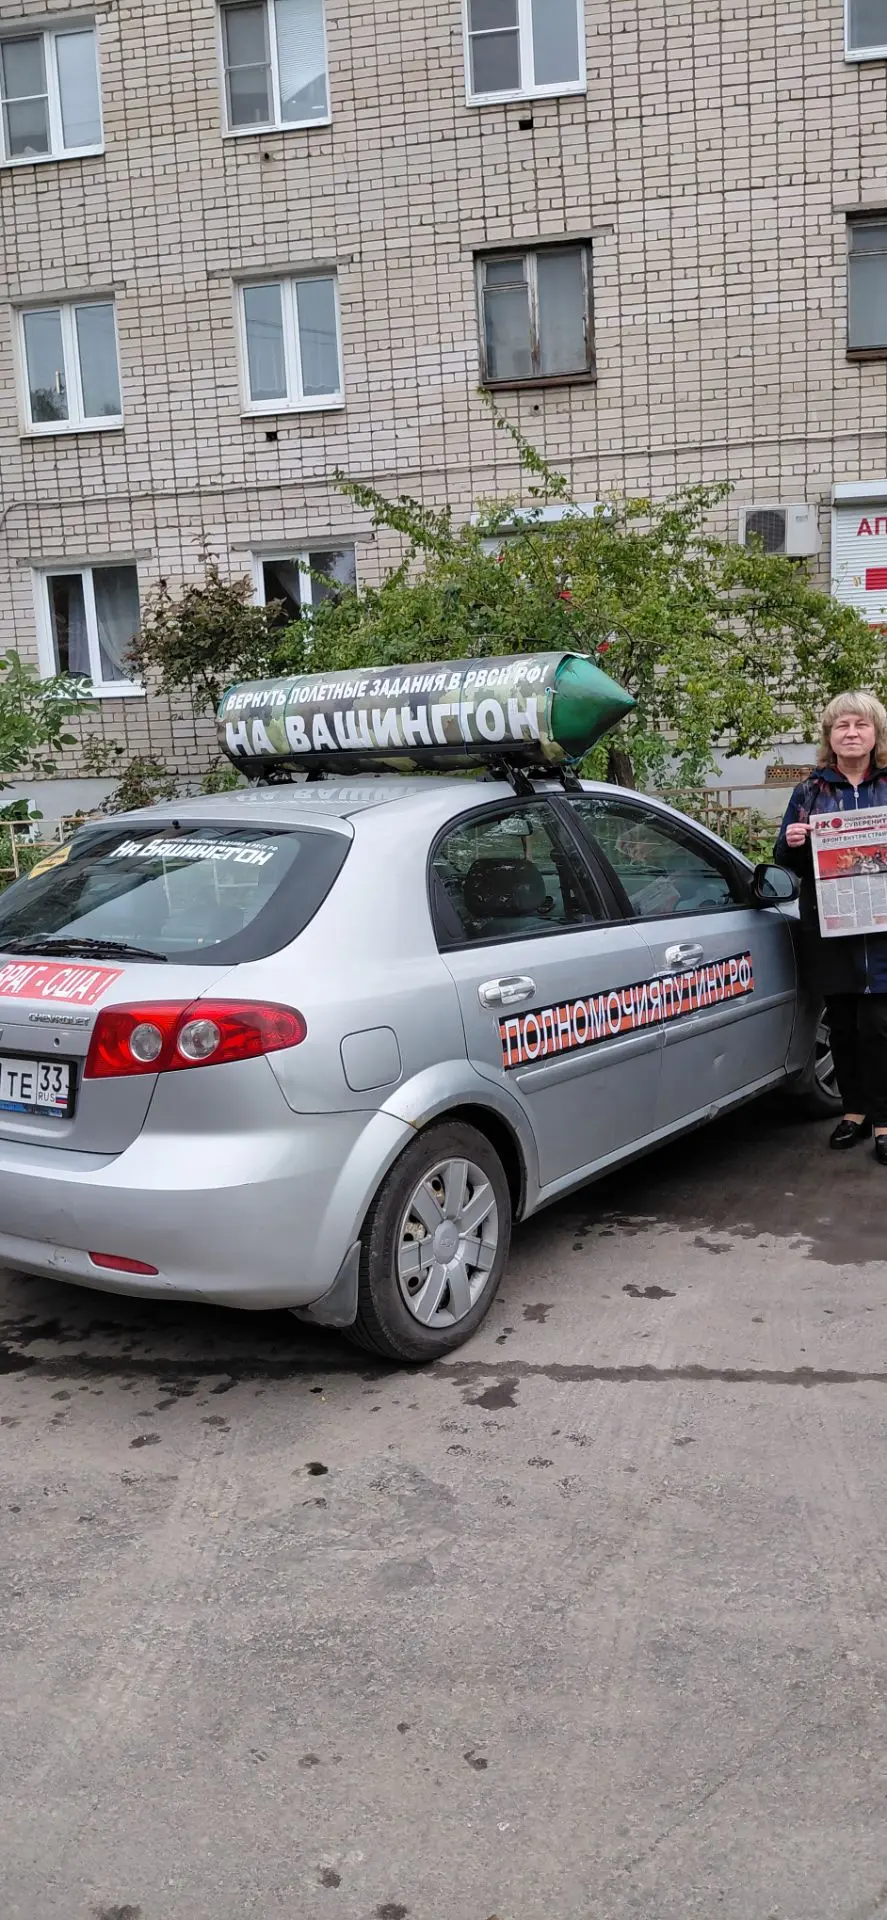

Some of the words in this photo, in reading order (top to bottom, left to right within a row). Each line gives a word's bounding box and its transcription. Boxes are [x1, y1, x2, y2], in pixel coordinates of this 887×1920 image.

[226, 689, 286, 711] ВЕРНУТЬ
[289, 680, 369, 704] ПОЛЕТНЫЕ
[370, 672, 446, 698] ЗАДАНИЯ
[449, 673, 461, 690] В
[463, 668, 508, 689] РВСН
[513, 664, 550, 684] РФ!
[226, 720, 277, 756] НА
[285, 698, 540, 753] ВАШИНГТОН
[42, 968, 116, 1001] США!
[29, 1012, 90, 1026] CHEVROLET
[504, 956, 751, 1065] ПОЛНОМОЧИЯПУТИНУ.РФ
[40, 1064, 63, 1092] 33
[38, 1091, 55, 1103] RUS
